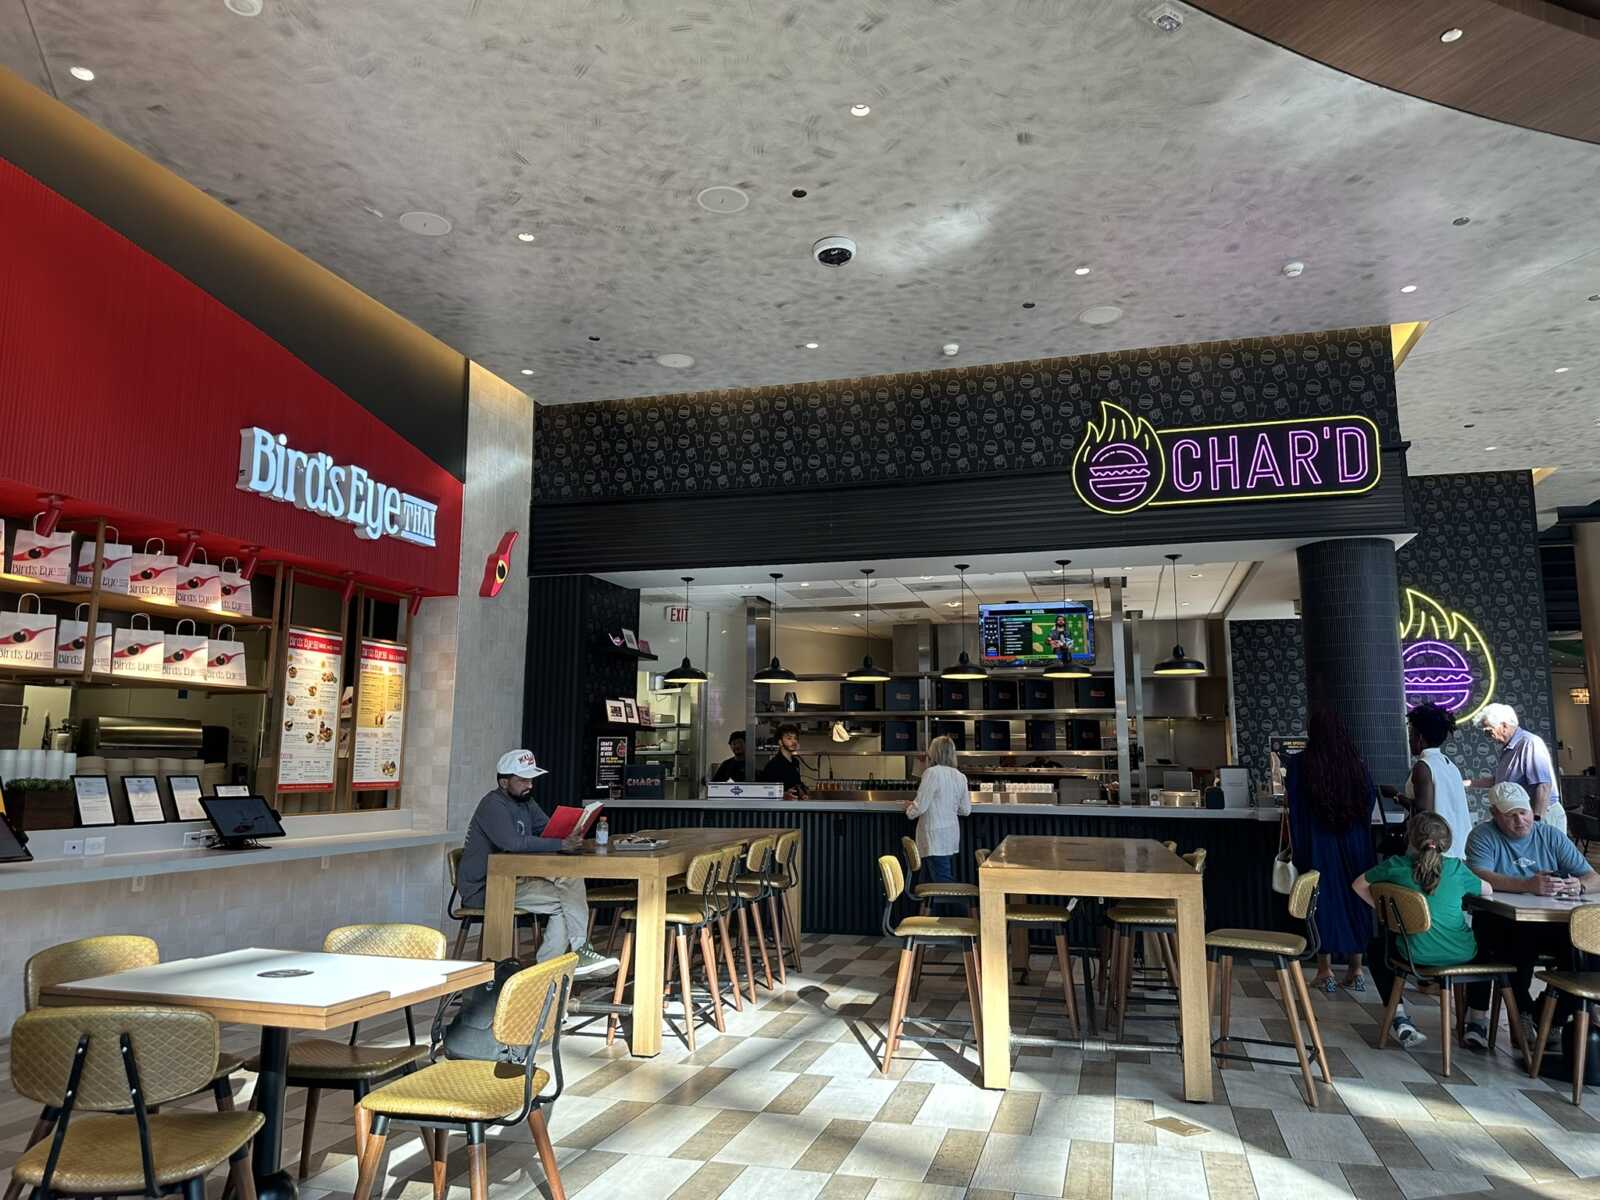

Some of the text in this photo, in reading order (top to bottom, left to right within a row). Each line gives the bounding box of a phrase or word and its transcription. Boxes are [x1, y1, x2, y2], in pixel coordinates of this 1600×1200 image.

[249, 426, 436, 540] Bird's Eye THAI
[1171, 426, 1369, 493] CHAR'D
[670, 607, 689, 623] EXIT
